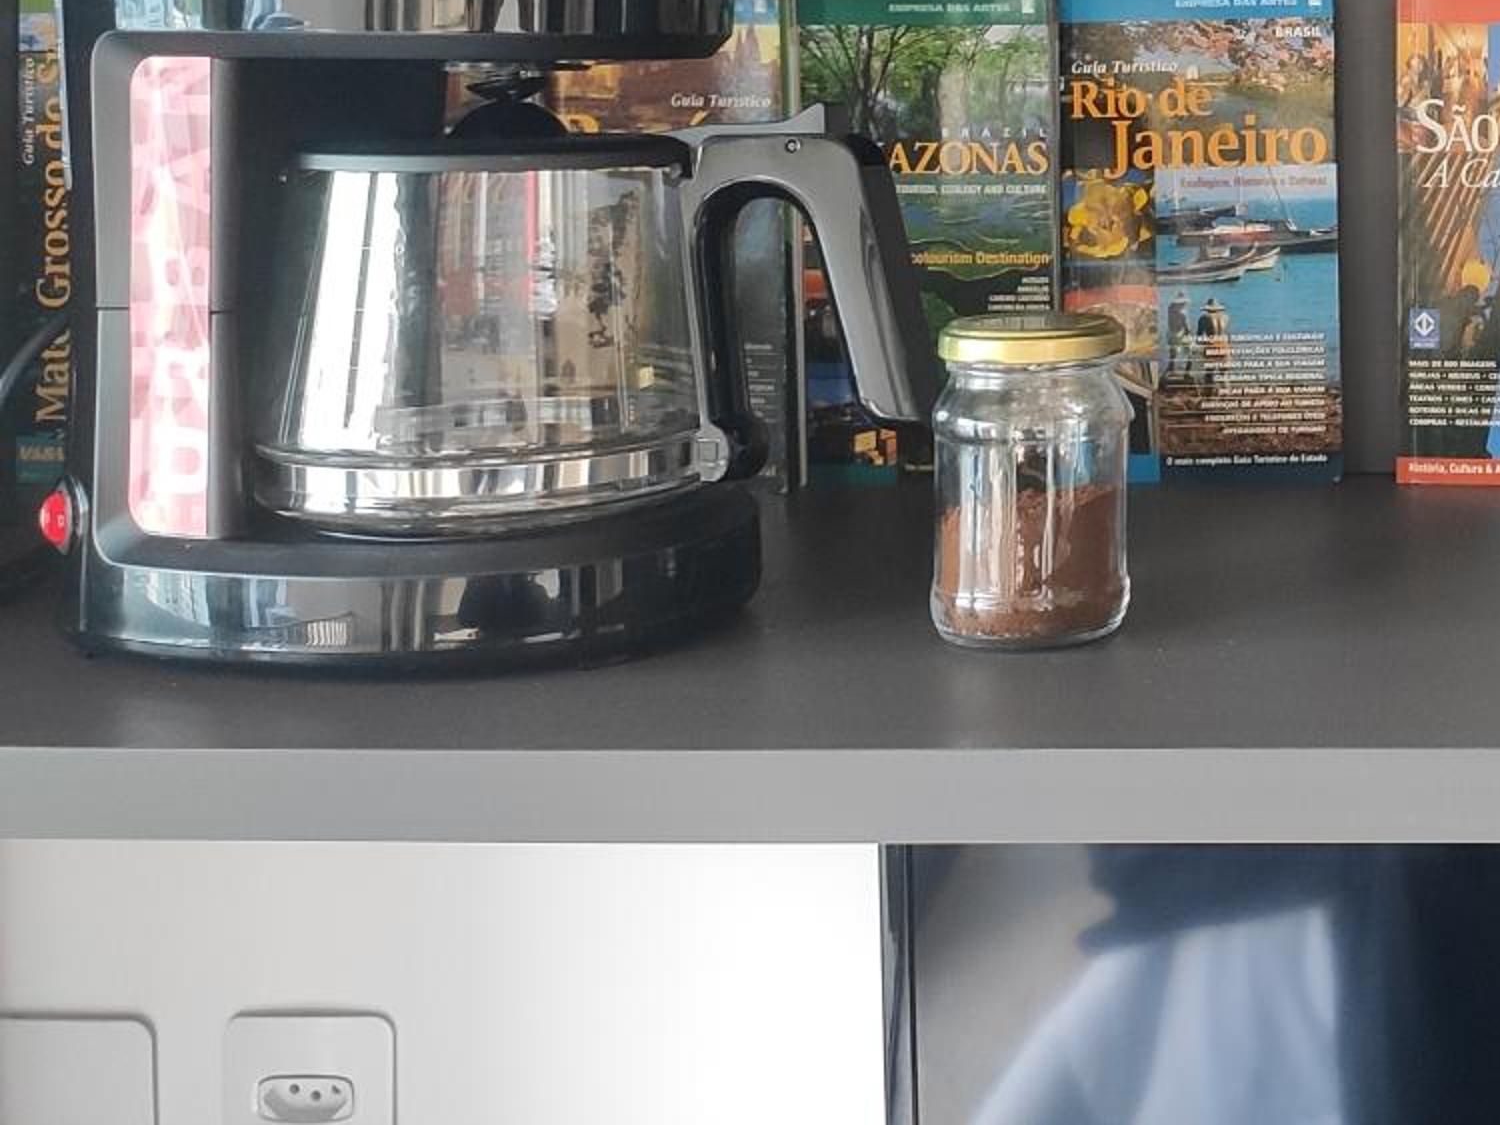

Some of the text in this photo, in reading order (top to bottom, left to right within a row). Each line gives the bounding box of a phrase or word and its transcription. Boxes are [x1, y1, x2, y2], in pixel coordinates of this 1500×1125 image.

[889, 2, 1011, 13] EMPRESA DAS ARTES
[1275, 27, 1322, 38] BRASIL
[1071, 60, 1178, 74] Guia Turístico
[670, 92, 772, 108] Guia Turístico
[1070, 76, 1214, 118] Rio de
[1104, 114, 1329, 180] Janeiro
[889, 140, 1050, 175] AZONAS
[1424, 159, 1449, 188] A
[34, 159, 71, 310] Grosso
[975, 250, 1050, 265] Destination
[1409, 462, 1445, 475] História,
[1449, 462, 1483, 474] Cultura
[1485, 463, 1492, 474] &
